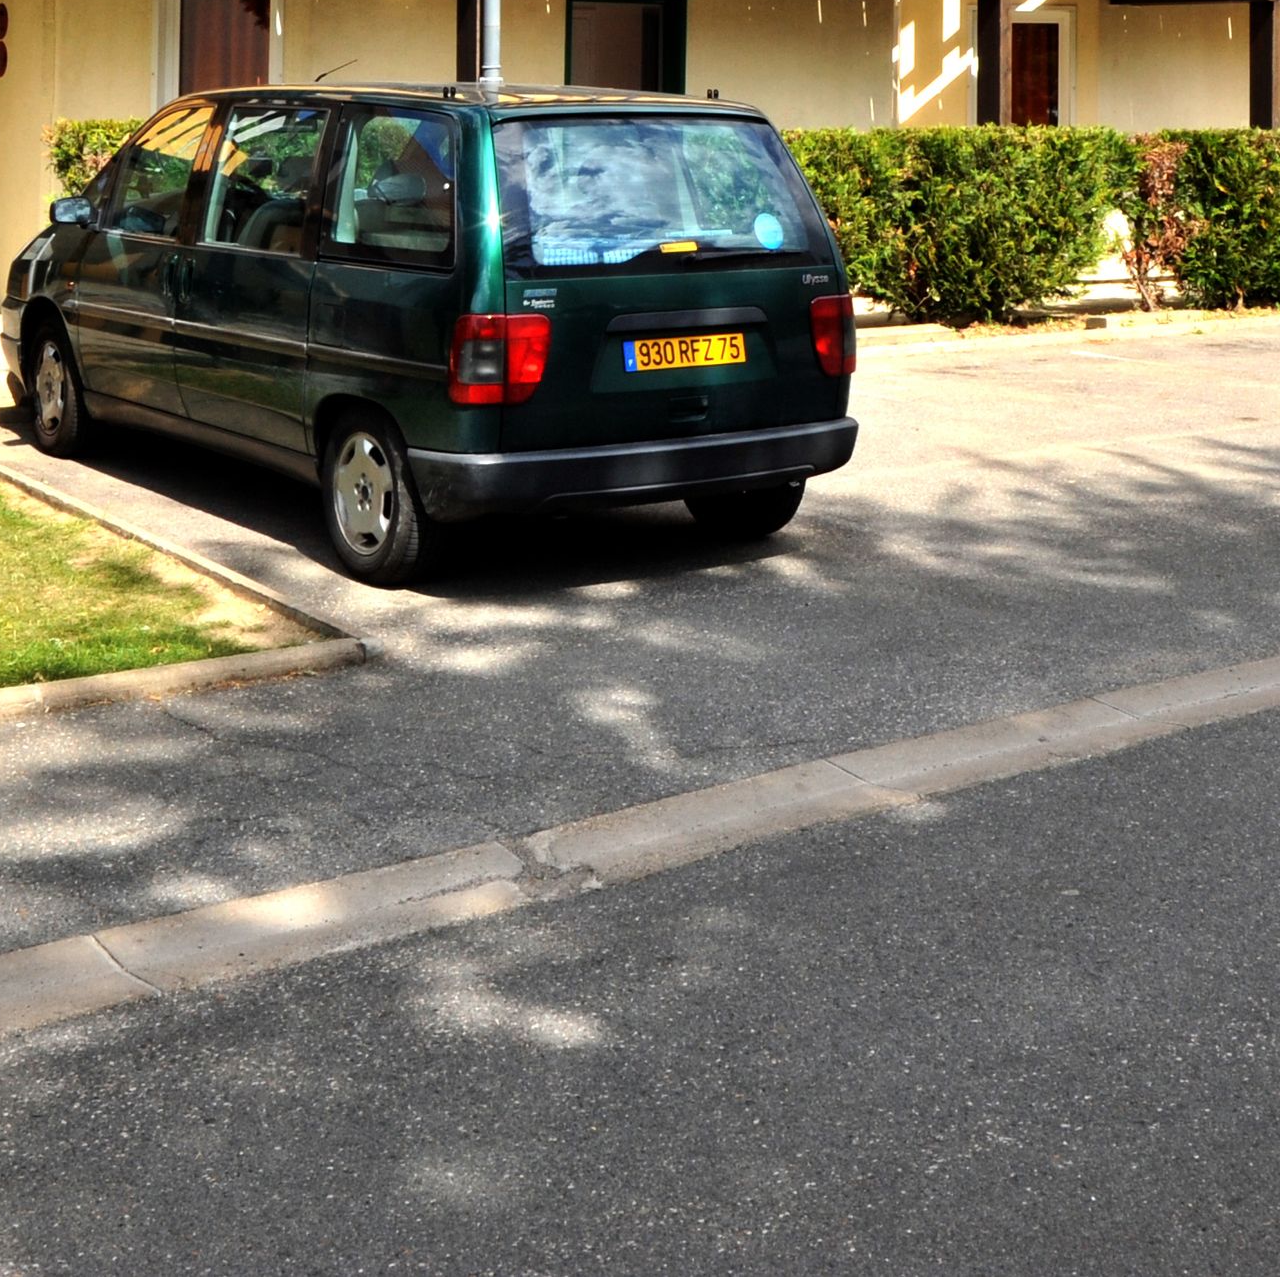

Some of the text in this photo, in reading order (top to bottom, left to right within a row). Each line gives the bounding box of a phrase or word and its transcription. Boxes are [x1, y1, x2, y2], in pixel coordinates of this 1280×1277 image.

[638, 341, 675, 366] 930
[678, 338, 713, 363] RFZ
[717, 336, 740, 360] 75
